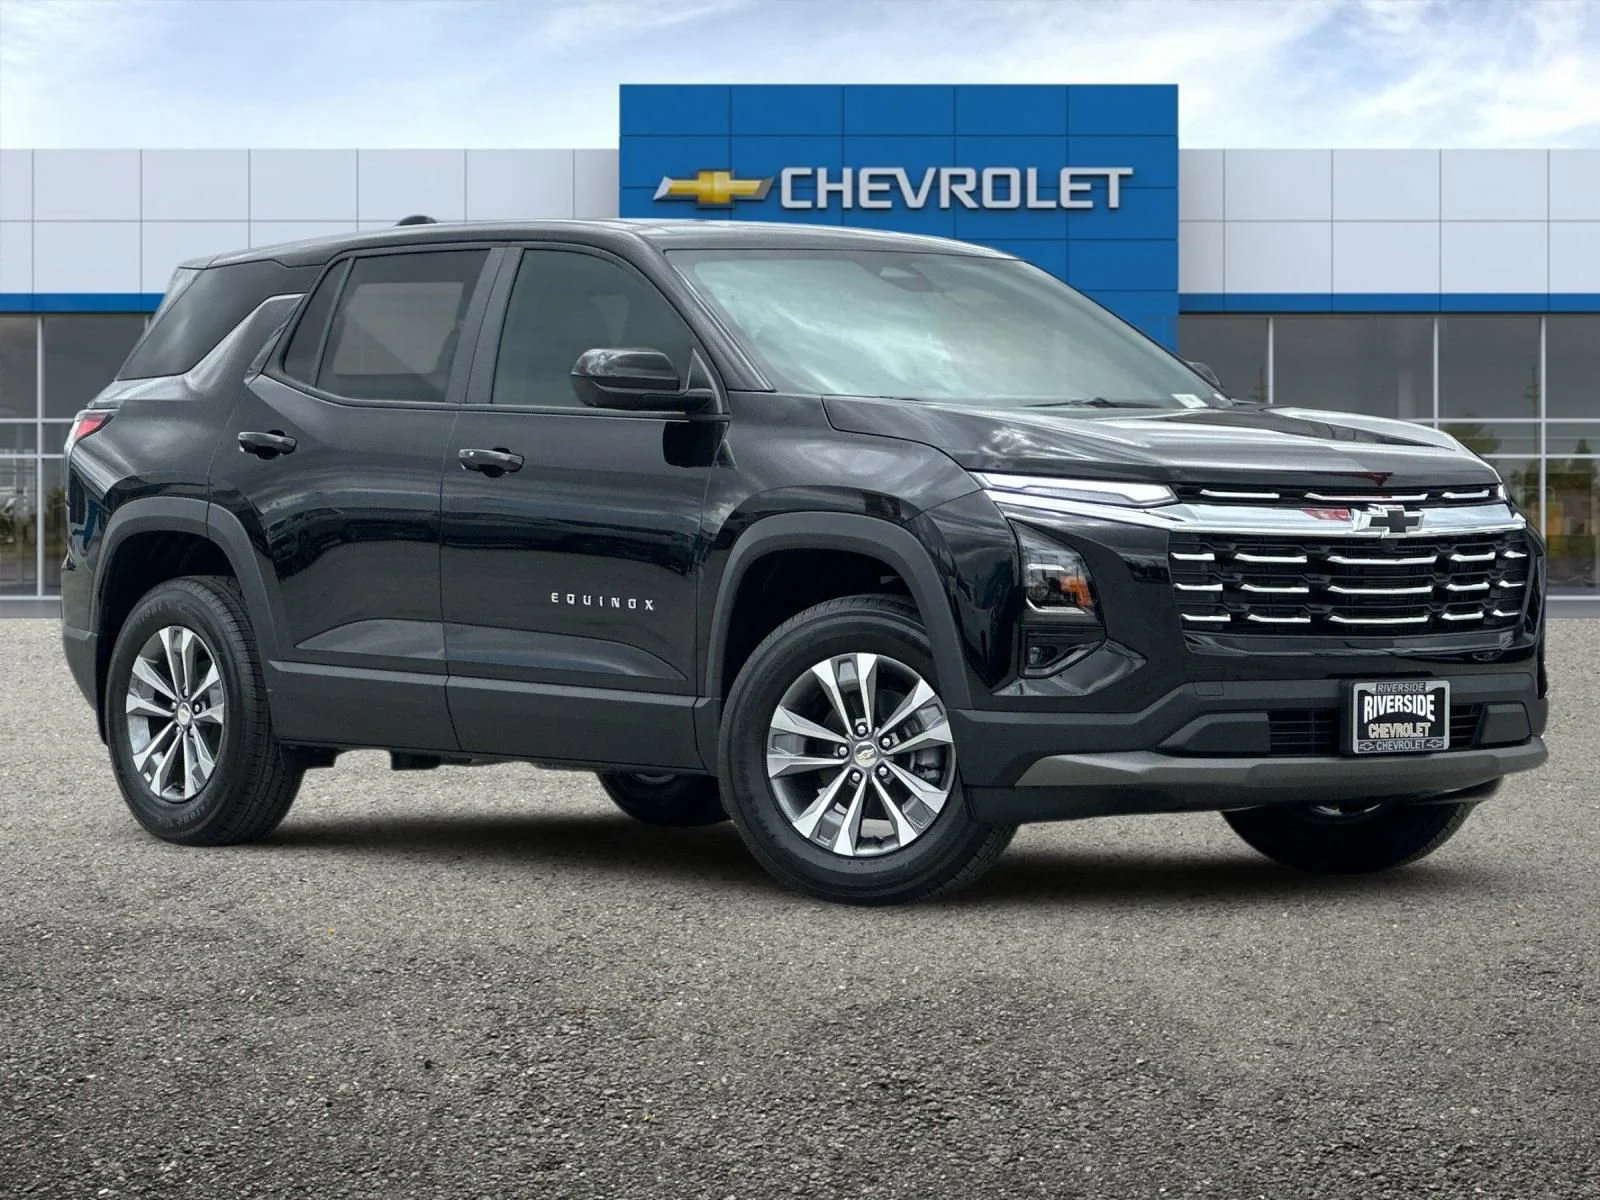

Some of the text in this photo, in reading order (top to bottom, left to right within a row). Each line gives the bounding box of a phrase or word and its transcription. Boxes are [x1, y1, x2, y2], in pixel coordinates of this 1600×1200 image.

[780, 167, 1134, 210] CHEVROLET
[551, 592, 654, 610] EQUINOX
[1377, 683, 1425, 693] RIVERSIDE
[1363, 694, 1435, 724] RIVERSIDE
[1368, 722, 1431, 739] CHEVROLET
[1376, 740, 1426, 751] CHEVROLET
